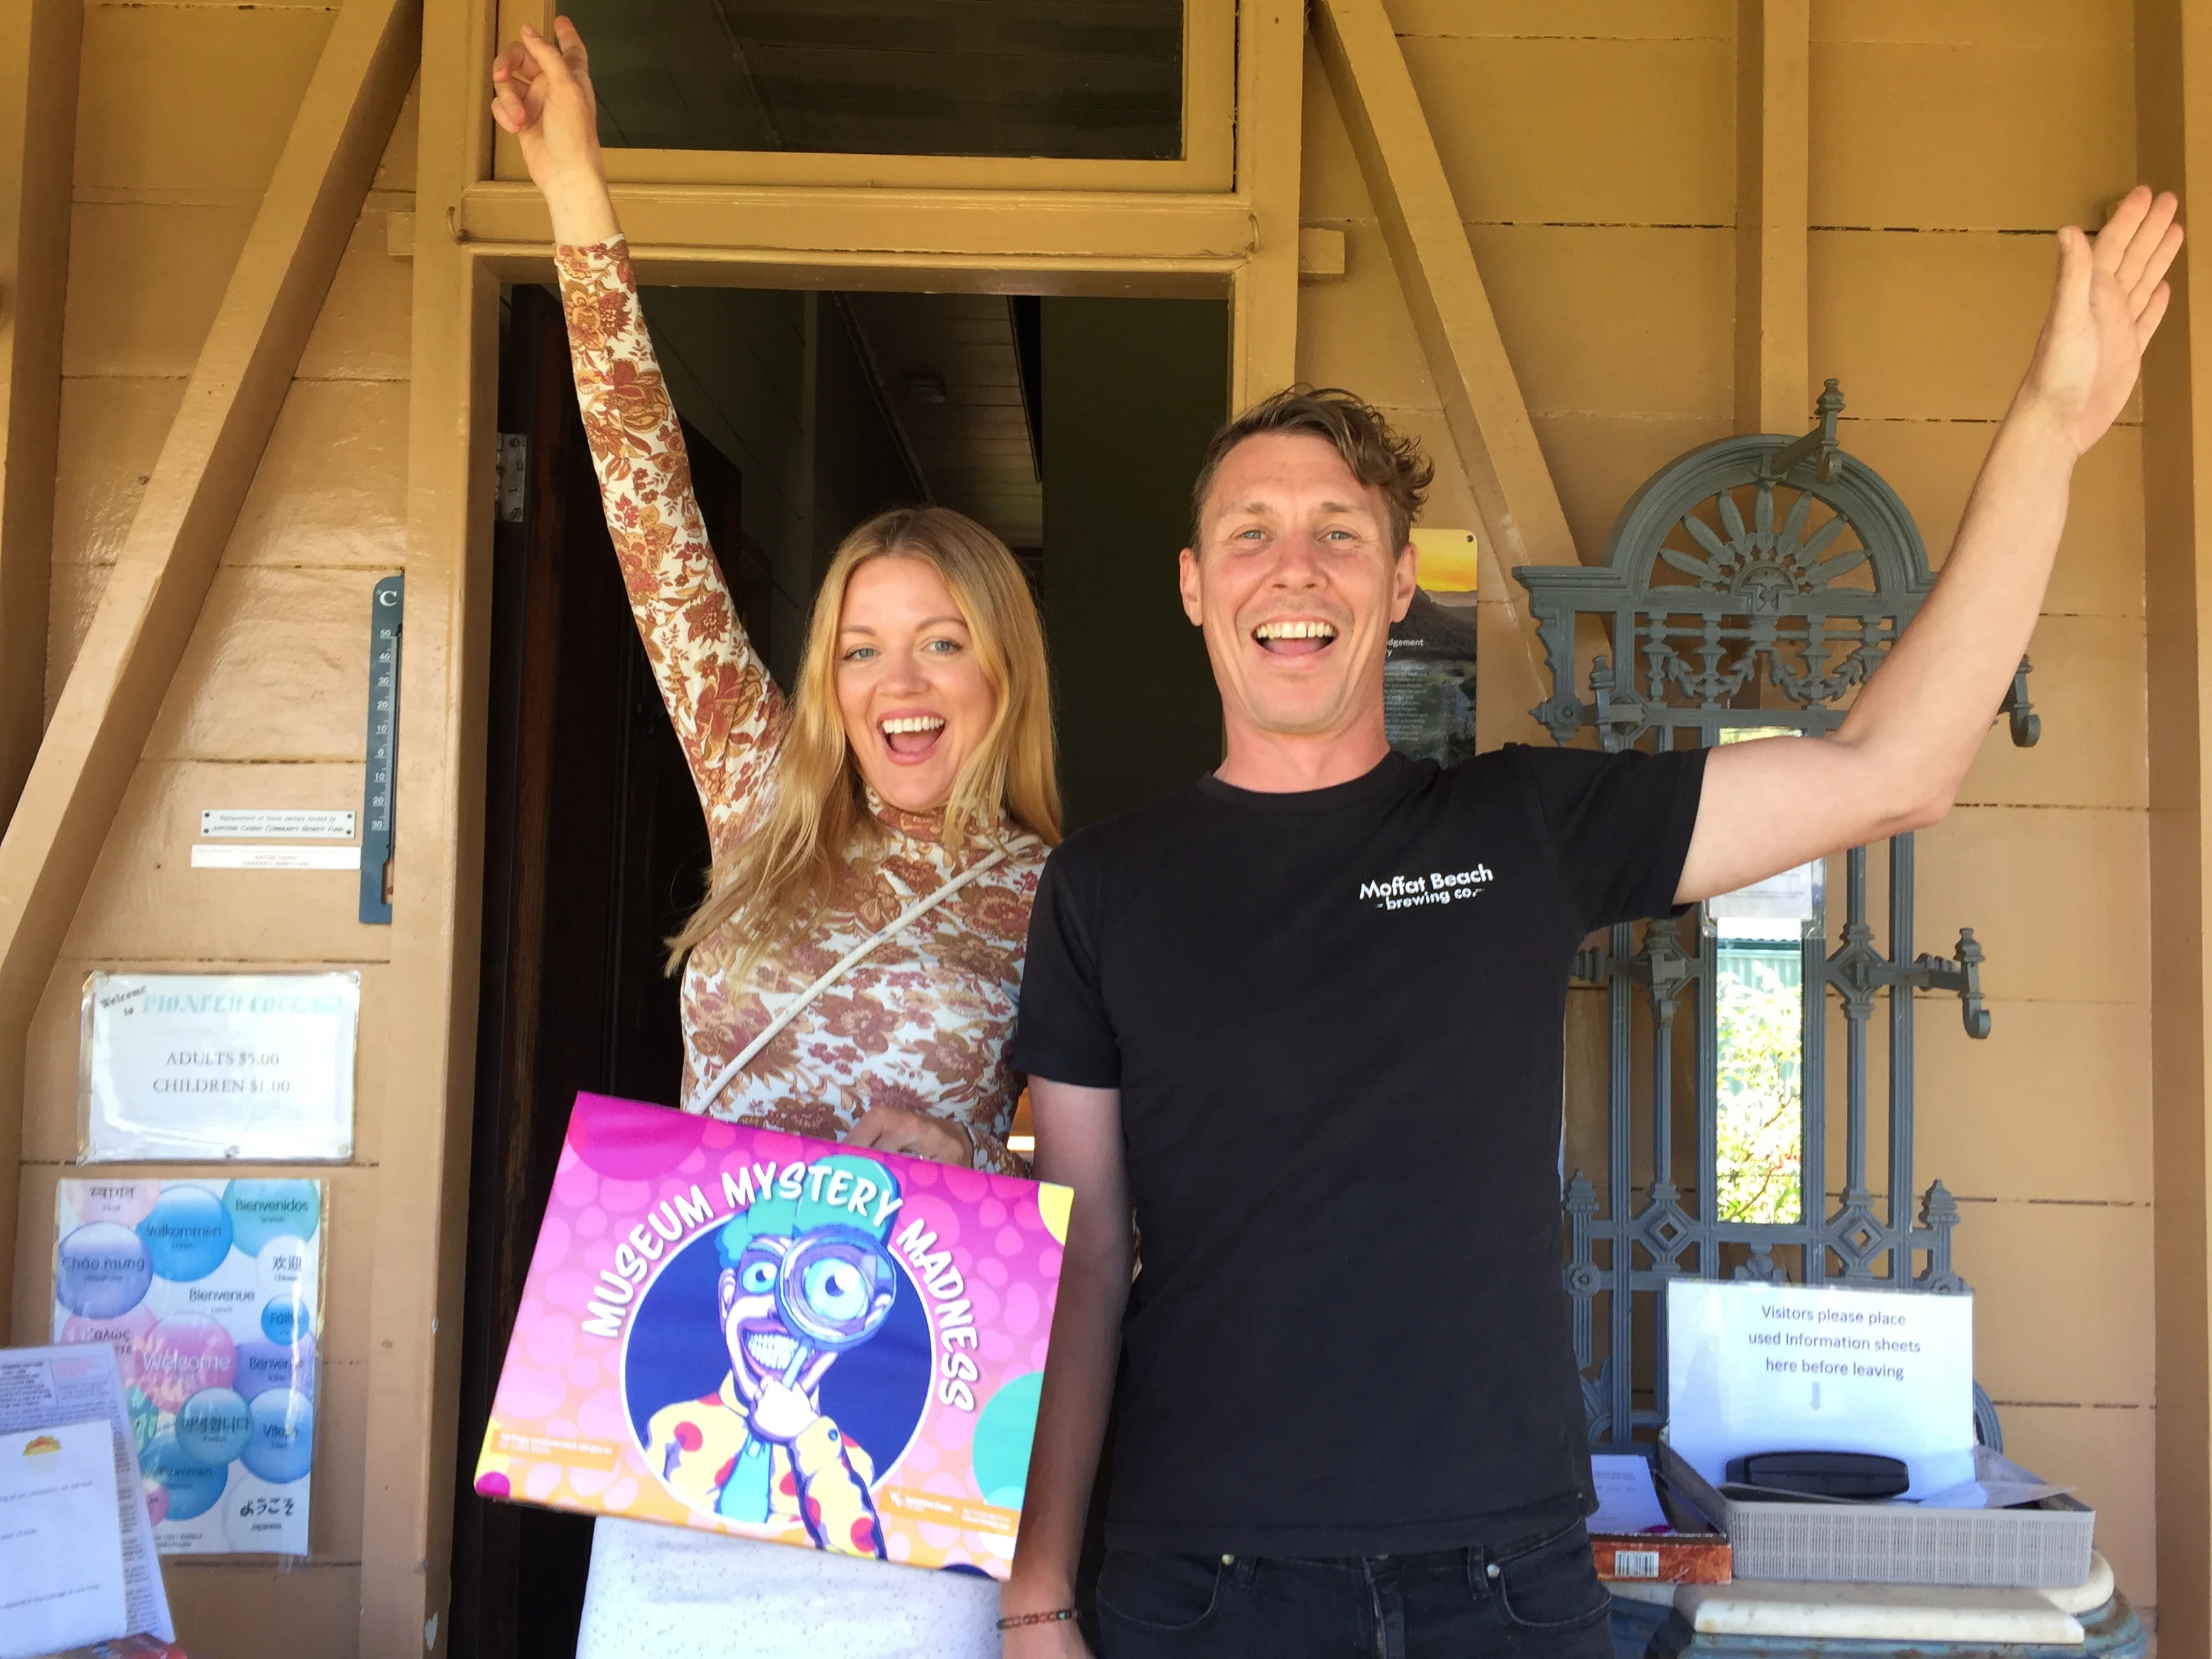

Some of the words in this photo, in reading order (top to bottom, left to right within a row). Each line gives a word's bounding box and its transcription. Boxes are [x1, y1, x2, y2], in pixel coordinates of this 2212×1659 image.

[380, 629, 391, 637] 50
[379, 653, 390, 661] 40
[378, 676, 389, 684] 30
[377, 700, 388, 708] 20
[376, 724, 387, 733] 10
[377, 748, 384, 756] 0
[375, 772, 385, 780] 10
[373, 796, 384, 804] 20
[372, 819, 383, 828] 30
[1359, 875, 1425, 900] Moffat
[1430, 863, 1494, 890] Beach
[1385, 890, 1450, 910] brewing
[100, 985, 146, 1009] Welcome
[142, 994, 242, 1014] PIONEER
[123, 1006, 134, 1017] to
[166, 1051, 233, 1066] ADULTS
[239, 1051, 279, 1067] $5.00
[153, 1078, 245, 1094] CHILDREN
[250, 1076, 290, 1094] $1.00
[235, 1197, 309, 1212] Bienvenidos
[189, 1288, 255, 1301] Bienvenue
[581, 1184, 714, 1338] MUSEUM
[722, 1162, 903, 1227] MYSTERY
[897, 1217, 979, 1412] MADNESS
[1761, 1305, 1814, 1322] Visitors
[1818, 1309, 1864, 1324] please
[1869, 1311, 1906, 1327] place
[1748, 1331, 1781, 1345] used
[1786, 1332, 1870, 1351] Information
[1875, 1337, 1921, 1353] sheets
[143, 1349, 231, 1372] Welcome
[1765, 1357, 1797, 1372] here
[1802, 1359, 1848, 1376] before
[1853, 1361, 1904, 1382] leaving
[240, 1496, 294, 1517] ようこそ
